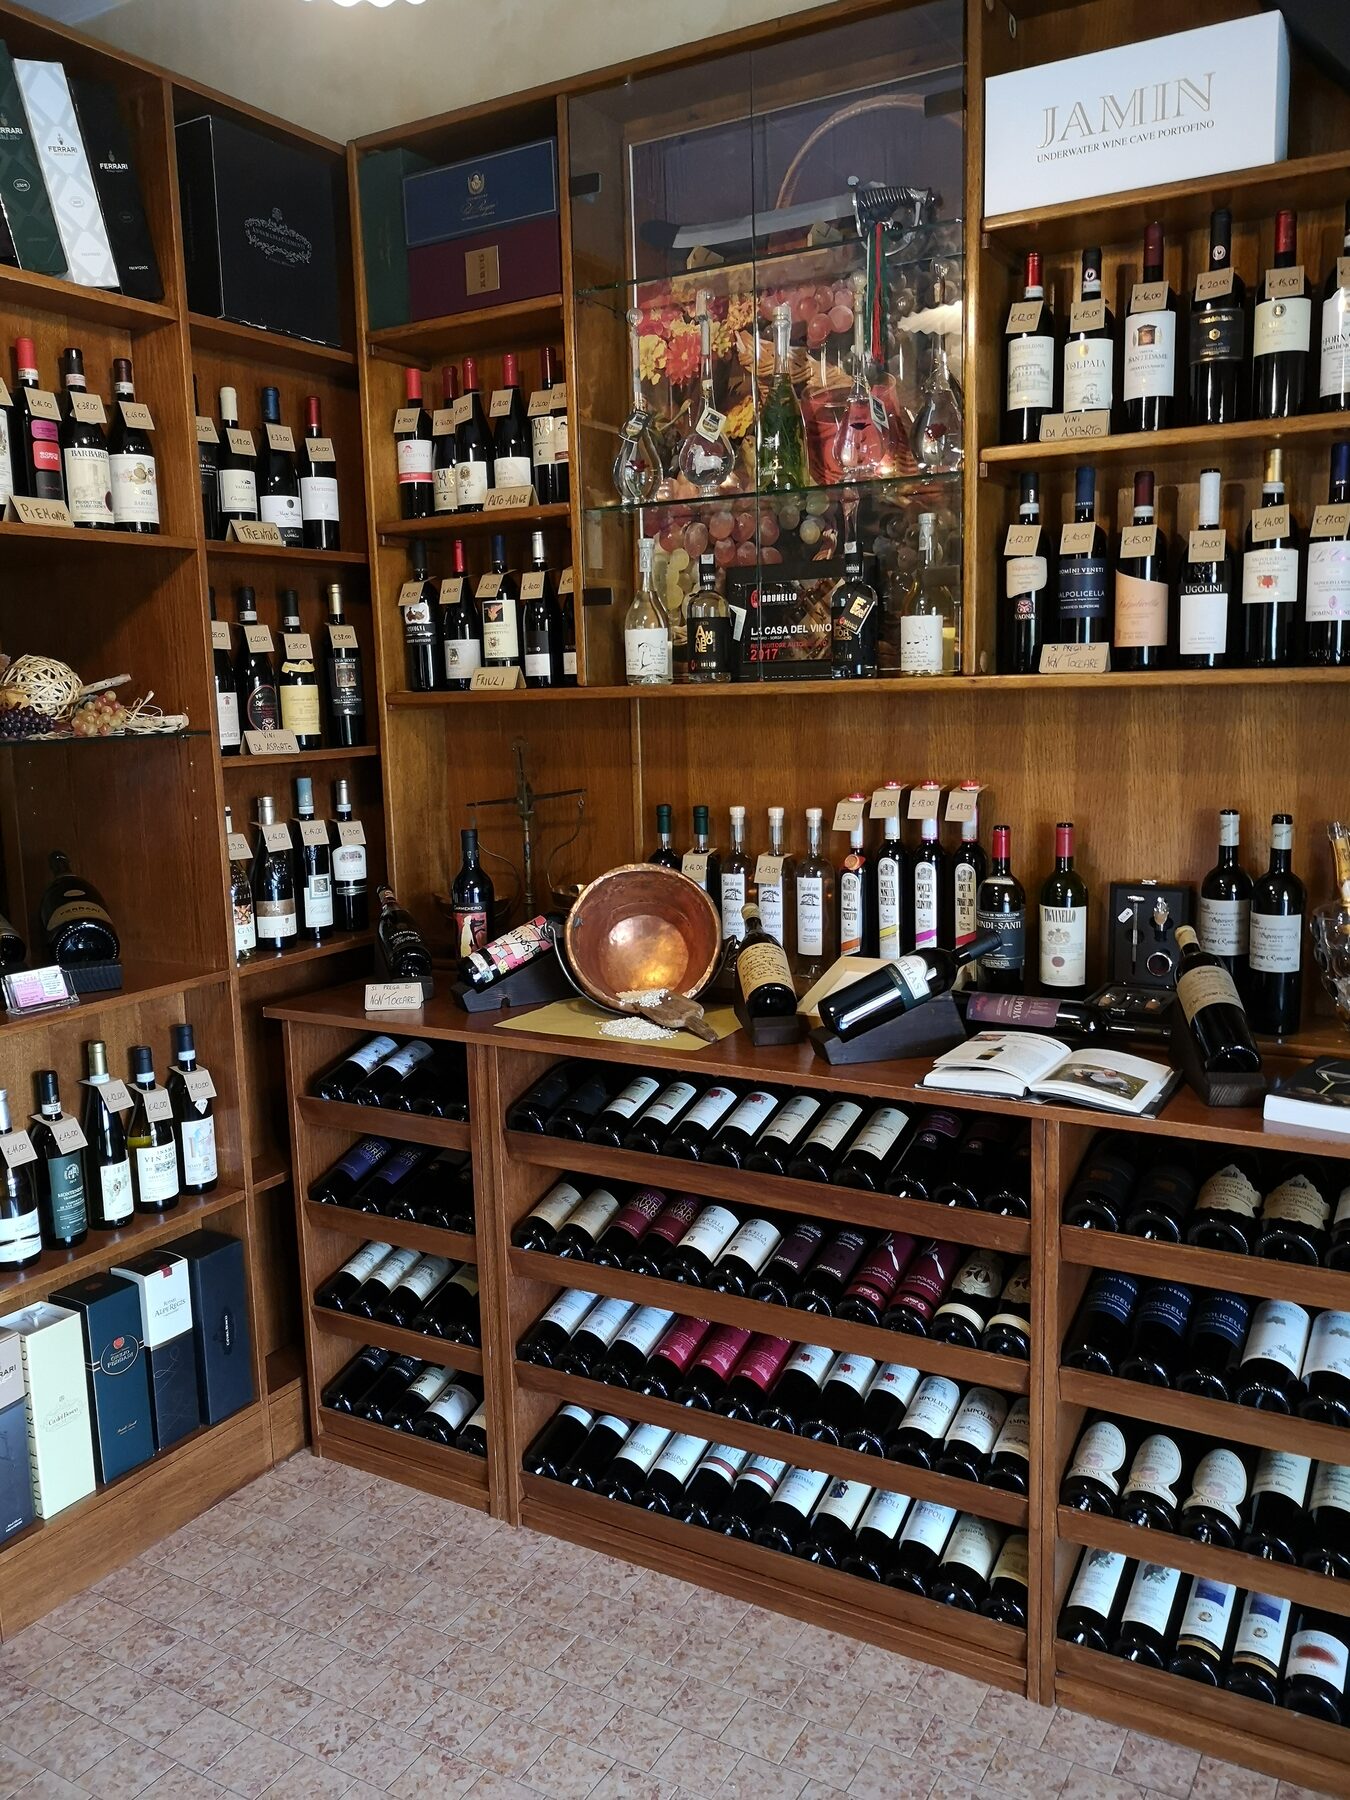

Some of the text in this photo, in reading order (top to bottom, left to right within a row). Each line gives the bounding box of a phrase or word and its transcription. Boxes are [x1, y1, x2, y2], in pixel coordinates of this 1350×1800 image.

[1036, 72, 1217, 150] JAMIN
[1036, 120, 1215, 164] UNDERWATER WINE CAVE PORTOFINO
[48, 145, 78, 154] FERRARI
[99, 162, 129, 171] FERRARI
[1063, 415, 1081, 424] VINI
[1045, 425, 1102, 438] DA ASPORTO
[1185, 583, 1223, 593] UGOLINI
[764, 626, 789, 635] CASA
[790, 624, 809, 634] DEL
[810, 623, 833, 633] VINO
[750, 648, 779, 661] 2017
[475, 673, 506, 688] FRIULI
[266, 742, 294, 753] ASPORTO
[385, 990, 417, 1005] TOCCARE
